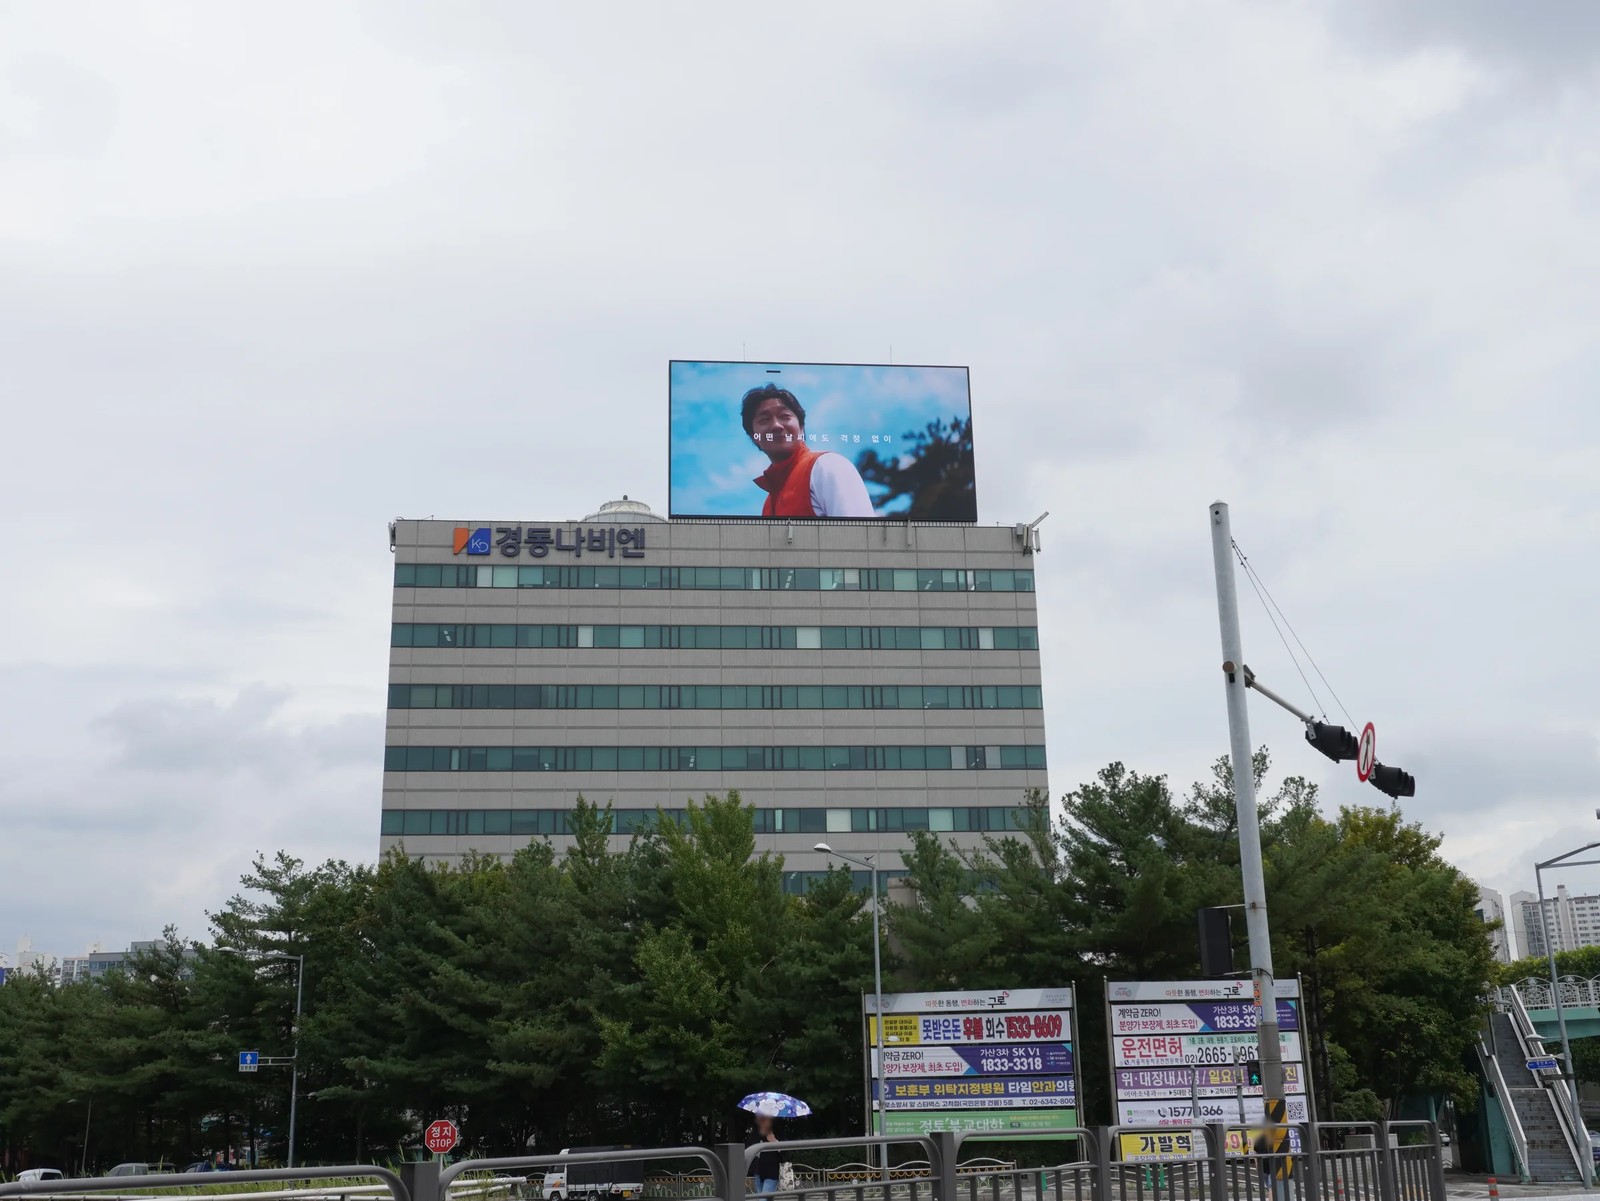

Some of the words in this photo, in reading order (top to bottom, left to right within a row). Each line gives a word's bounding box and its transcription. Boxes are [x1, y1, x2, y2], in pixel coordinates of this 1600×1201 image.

[753, 433, 774, 442] 어떤
[785, 433, 829, 442] 날씨에도
[840, 434, 861, 443] 걱정
[871, 435, 891, 443] 없이
[496, 526, 645, 557] 경동나비엔
[1198, 988, 1222, 996] 변화하는
[1223, 986, 1240, 999] 구로
[925, 1000, 944, 1008] 따뜻한
[961, 998, 986, 1007] 변화하는
[987, 995, 1007, 1008] 구로
[1118, 1007, 1139, 1018] 계약금
[1140, 1008, 1161, 1017] ZERO!
[985, 1017, 1005, 1039] 회수
[1004, 1014, 1062, 1039] 1533-8609
[1119, 1020, 1140, 1031] 분양가
[1166, 1019, 1180, 1030] 최초
[1181, 1019, 1198, 1029] 도입!
[1214, 1014, 1257, 1029] 1833-33
[1012, 1047, 1026, 1057] SK
[1028, 1047, 1040, 1056] V1
[1121, 1036, 1183, 1058] 운전면허
[902, 1051, 924, 1060] ZERO!
[928, 1062, 944, 1072] 최초
[944, 1061, 963, 1072] 도입!
[980, 1057, 1042, 1072] 1833-3318
[895, 1084, 930, 1096] 보훈부
[934, 1082, 1005, 1096] 위탁지정병원
[431, 1126, 452, 1138] 정지
[430, 1138, 452, 1148] STOP
